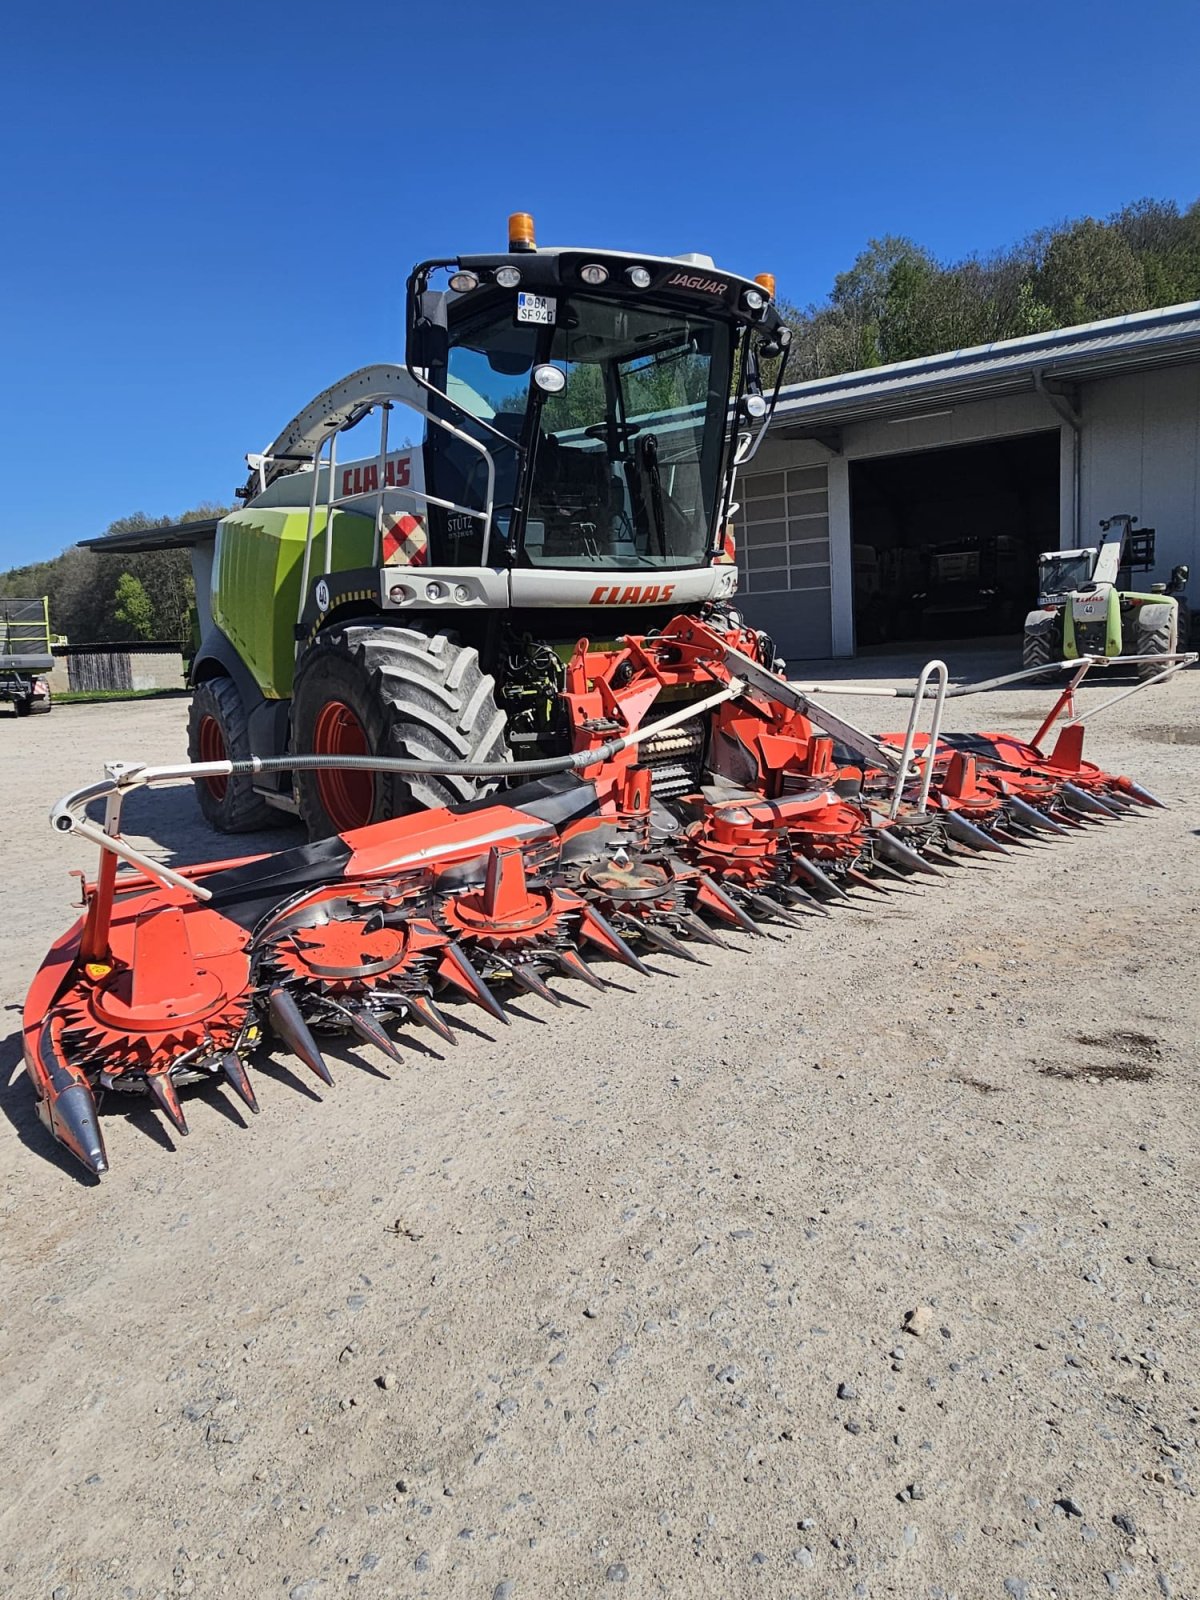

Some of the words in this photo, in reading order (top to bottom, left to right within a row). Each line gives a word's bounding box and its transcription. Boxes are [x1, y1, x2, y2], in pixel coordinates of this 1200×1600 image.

[668, 273, 728, 295] JAGUAR
[534, 297, 547, 309] BA
[521, 308, 534, 320] SF
[535, 310, 553, 322] 940
[342, 457, 411, 496] CLAAS
[447, 514, 473, 532] STÜTZ
[319, 585, 327, 605] 40
[588, 584, 676, 605] CLAAS
[1075, 596, 1105, 604] CLAAS
[1085, 605, 1093, 613] 40
